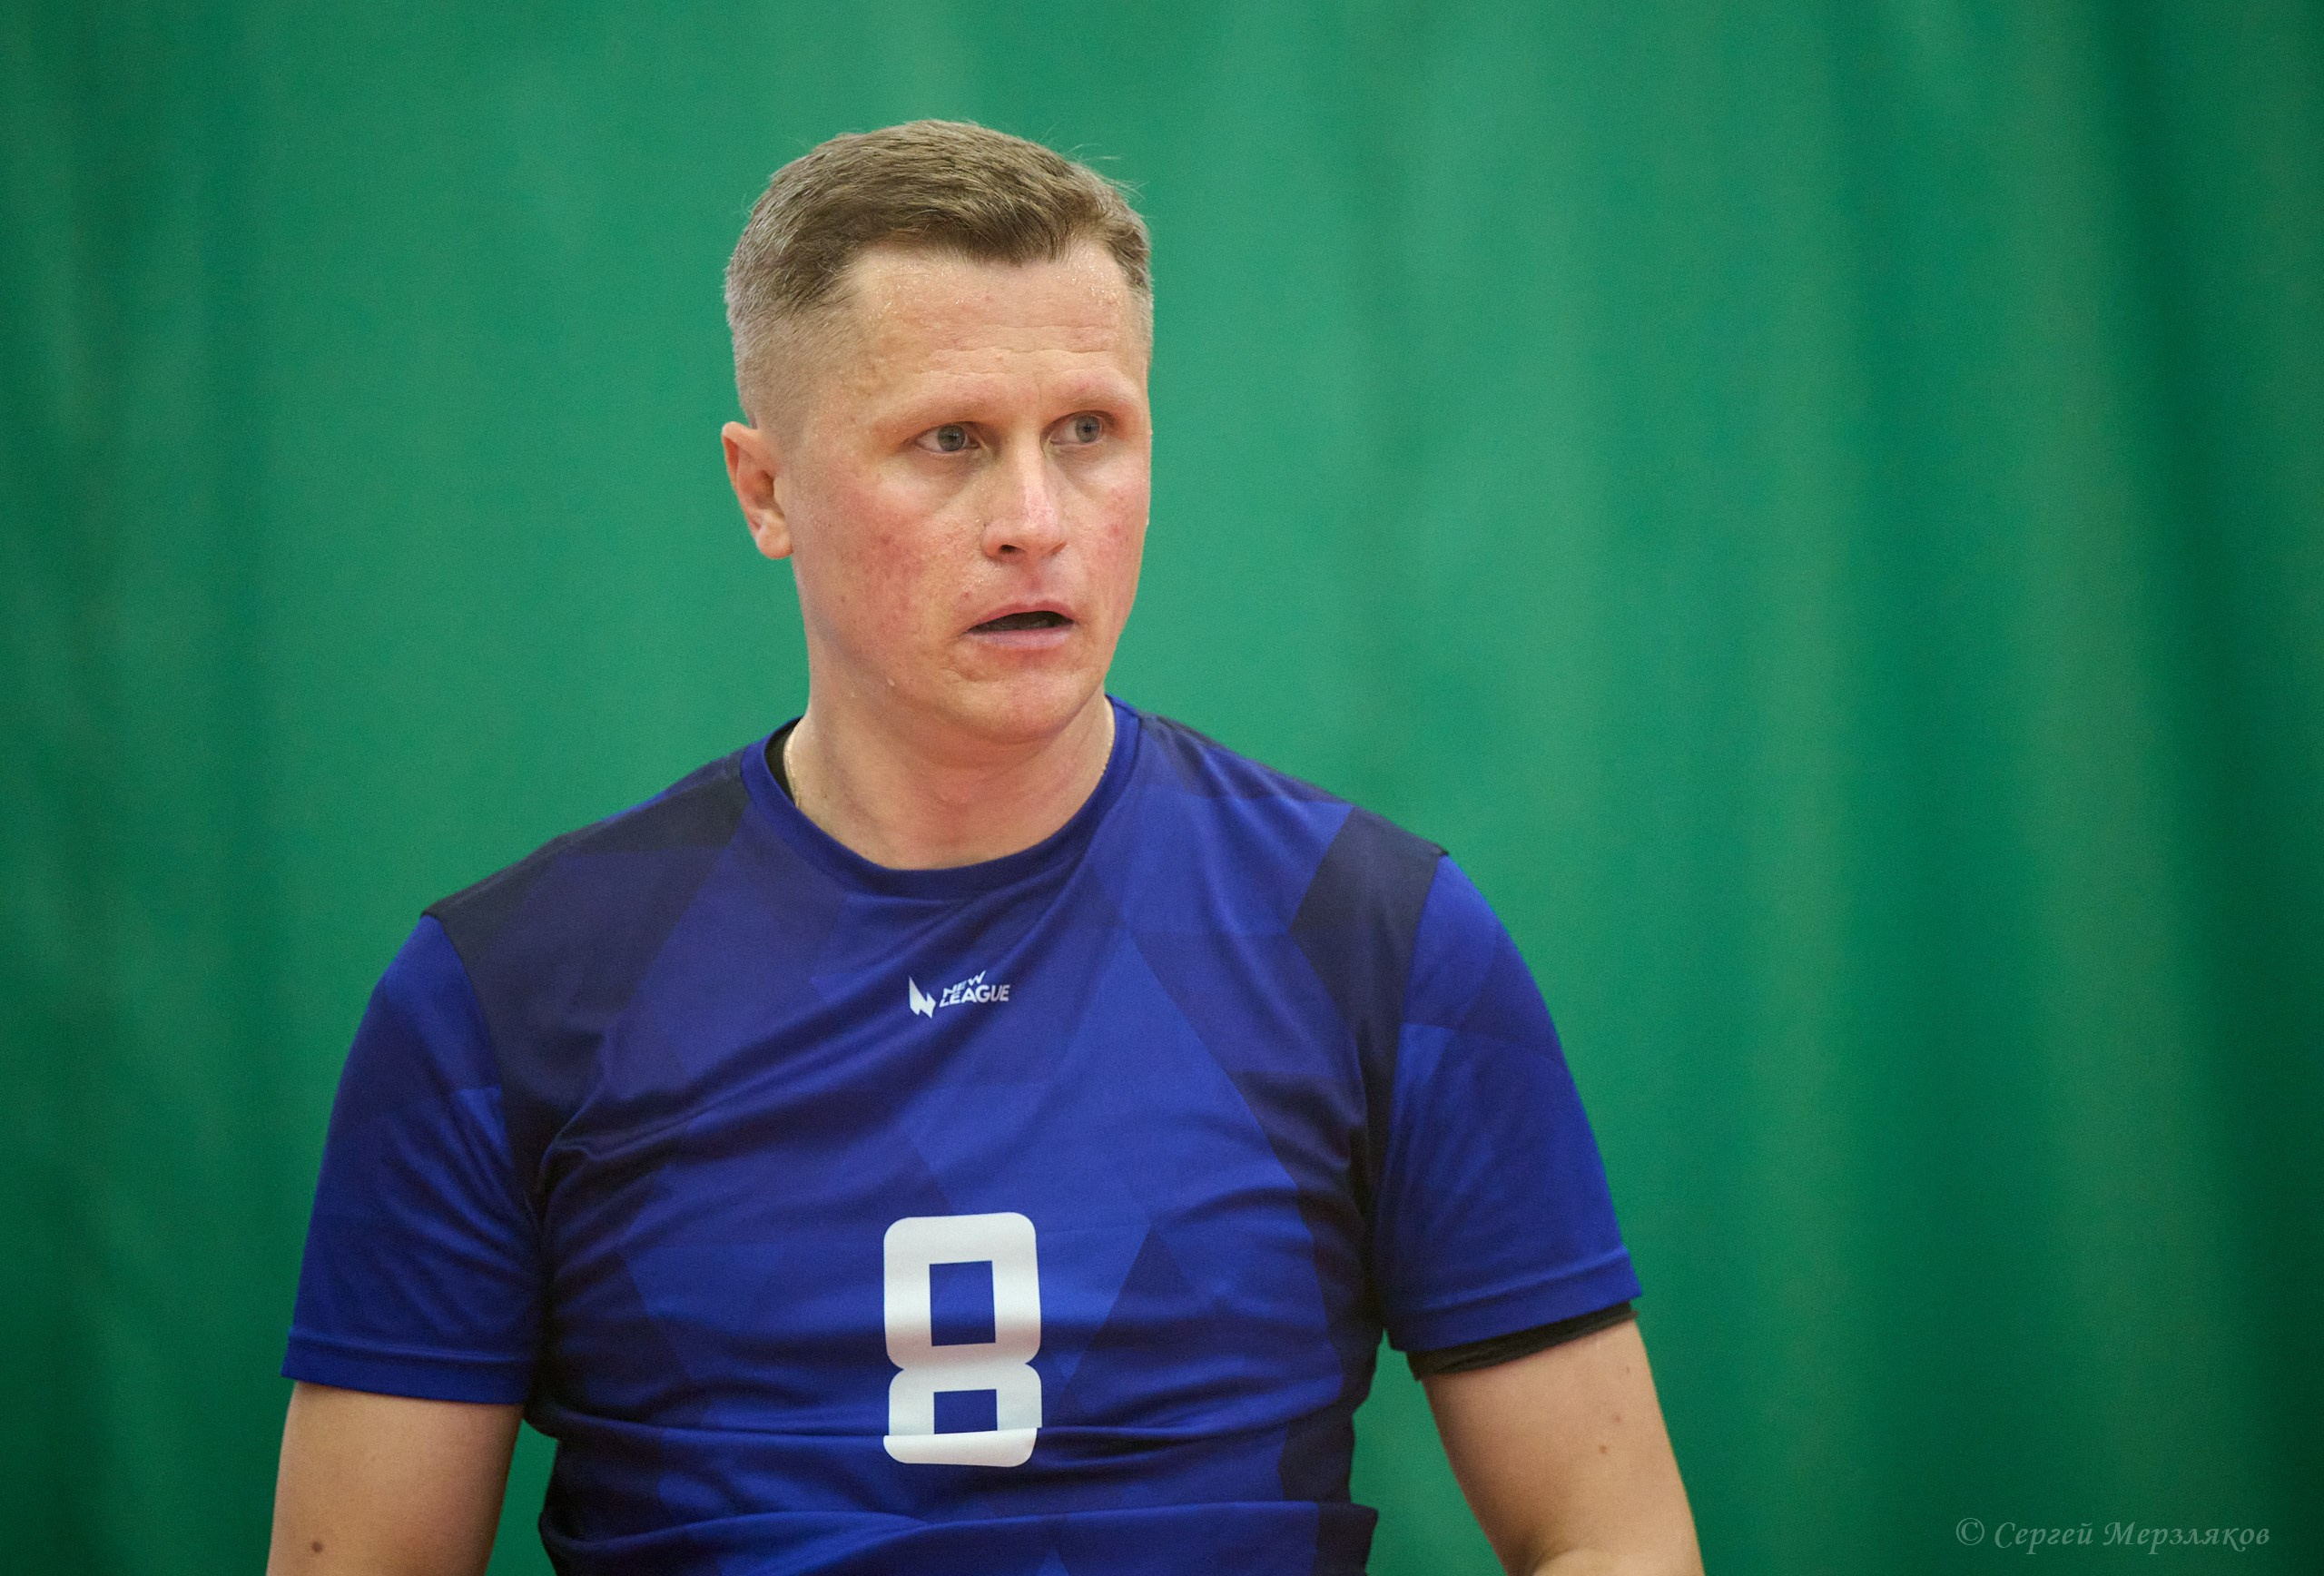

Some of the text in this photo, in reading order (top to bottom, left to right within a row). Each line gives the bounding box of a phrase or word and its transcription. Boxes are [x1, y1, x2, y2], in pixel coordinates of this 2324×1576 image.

[939, 984, 1010, 1008] LEAGUE
[943, 970, 987, 996] NEW
[883, 1212, 1042, 1467] 8
